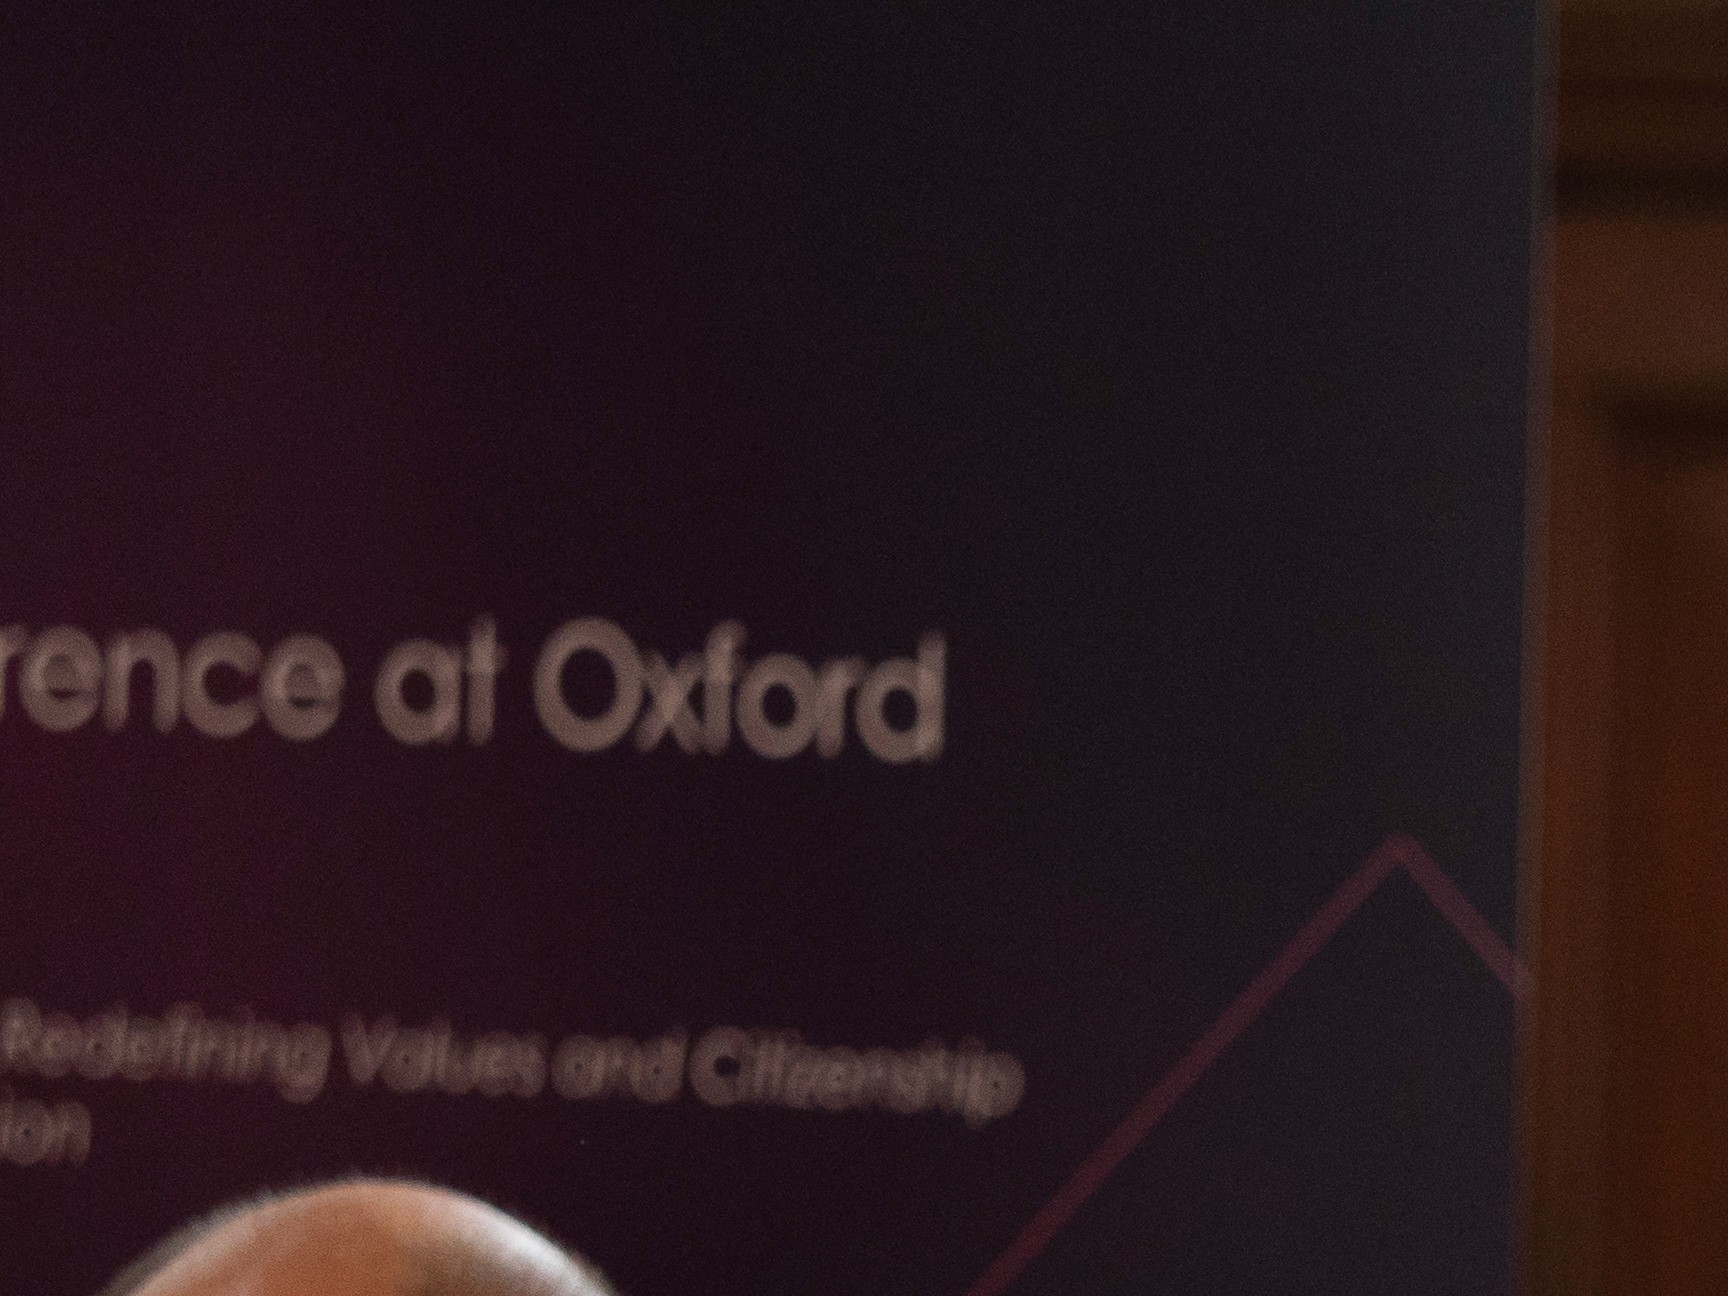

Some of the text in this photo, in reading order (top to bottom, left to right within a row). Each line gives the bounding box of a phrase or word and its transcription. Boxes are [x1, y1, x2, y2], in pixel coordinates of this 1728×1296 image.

[376, 612, 506, 747] at
[534, 615, 947, 764] Oxford
[0, 996, 1025, 1129] Redefining Values and Citizenship
